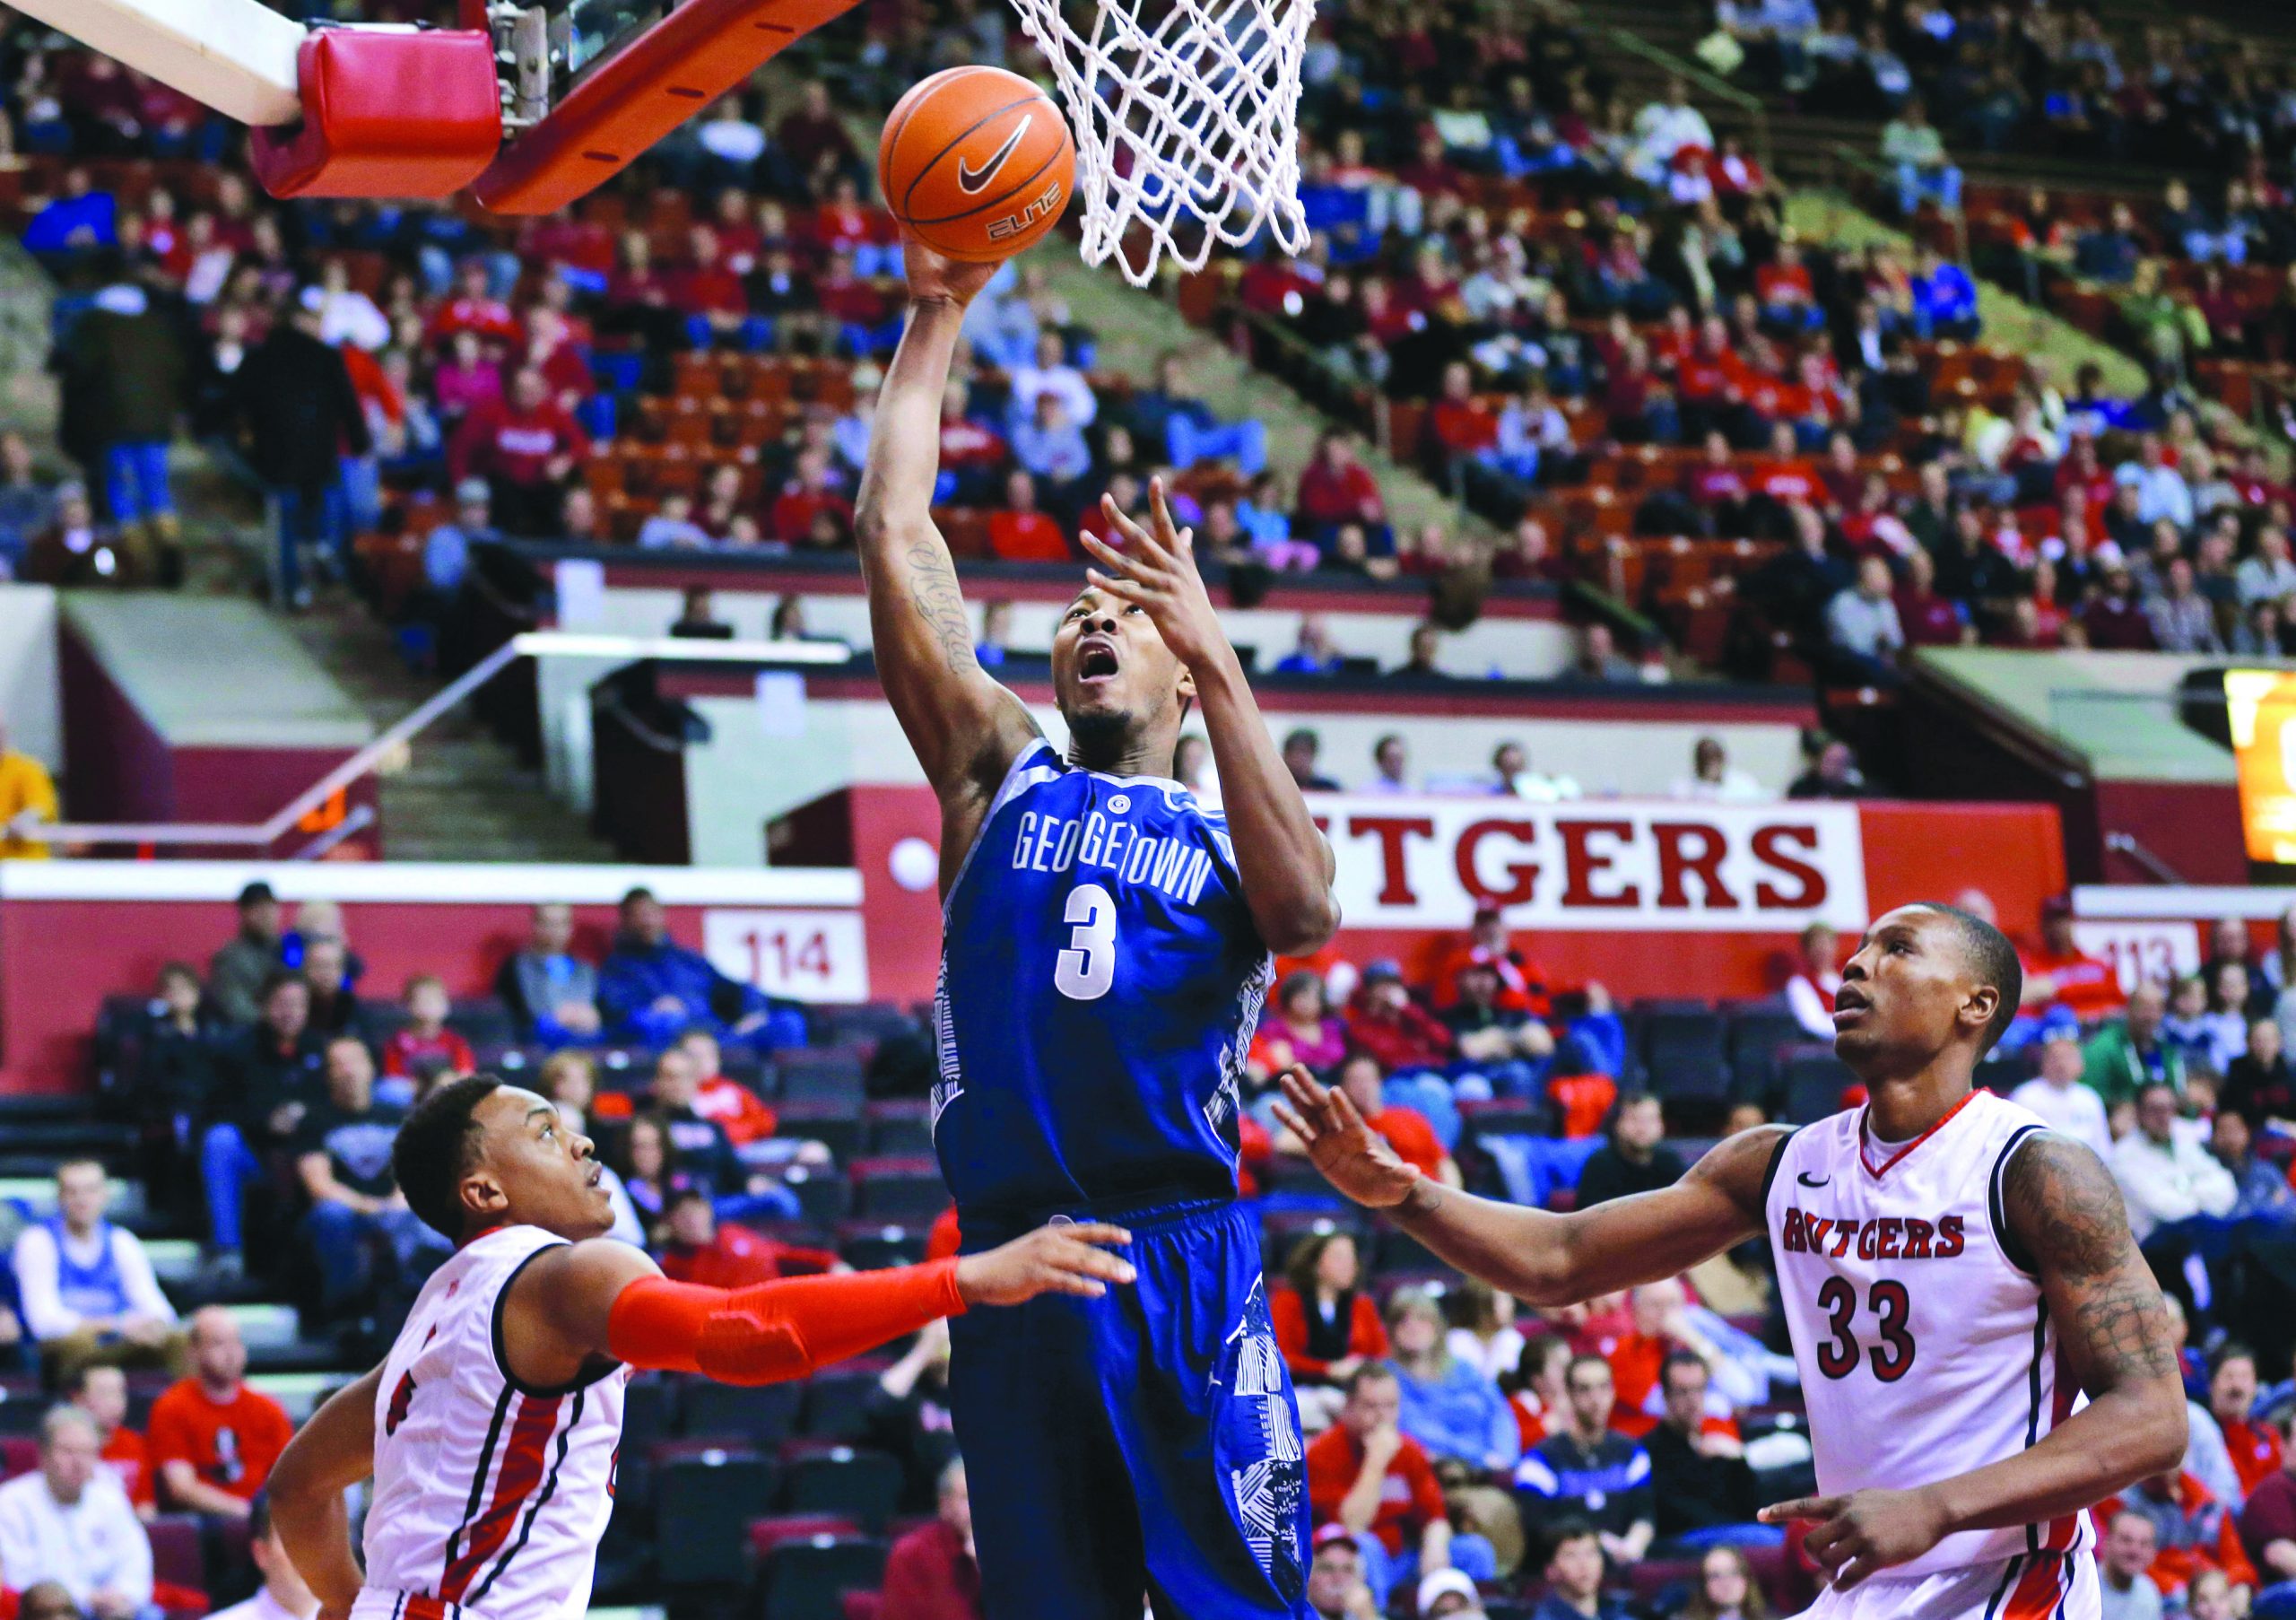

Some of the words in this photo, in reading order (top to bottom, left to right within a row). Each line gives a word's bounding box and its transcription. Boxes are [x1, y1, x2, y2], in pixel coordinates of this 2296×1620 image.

[987, 181, 1062, 241] ELITE
[1317, 816, 1827, 910] TGERS
[744, 931, 831, 984] 114
[1054, 884, 1117, 1000] 3
[1783, 1206, 1965, 1261] RUTGERS
[1816, 1276, 1916, 1383] 33
